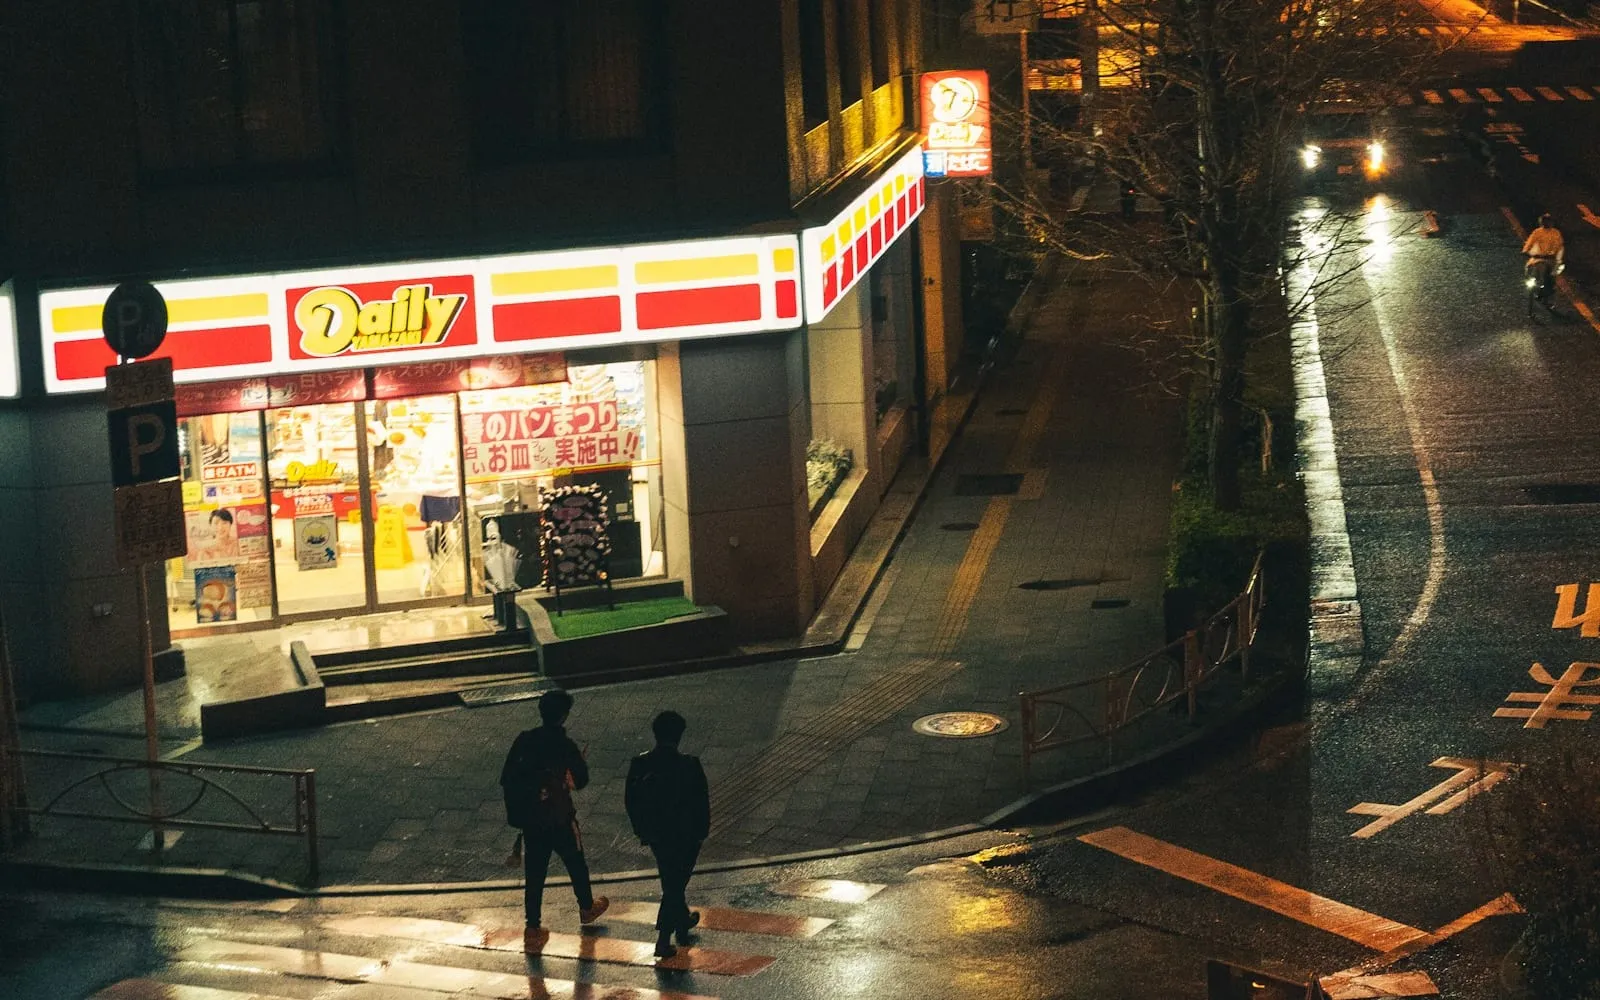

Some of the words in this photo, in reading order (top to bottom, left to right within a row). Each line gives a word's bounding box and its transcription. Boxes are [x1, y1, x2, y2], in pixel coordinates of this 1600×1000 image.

[117, 300, 142, 349] P
[298, 285, 465, 356] Daily
[352, 329, 423, 350] YAMAZAKI
[126, 413, 165, 477] P
[463, 401, 618, 445] 春のパンまつり
